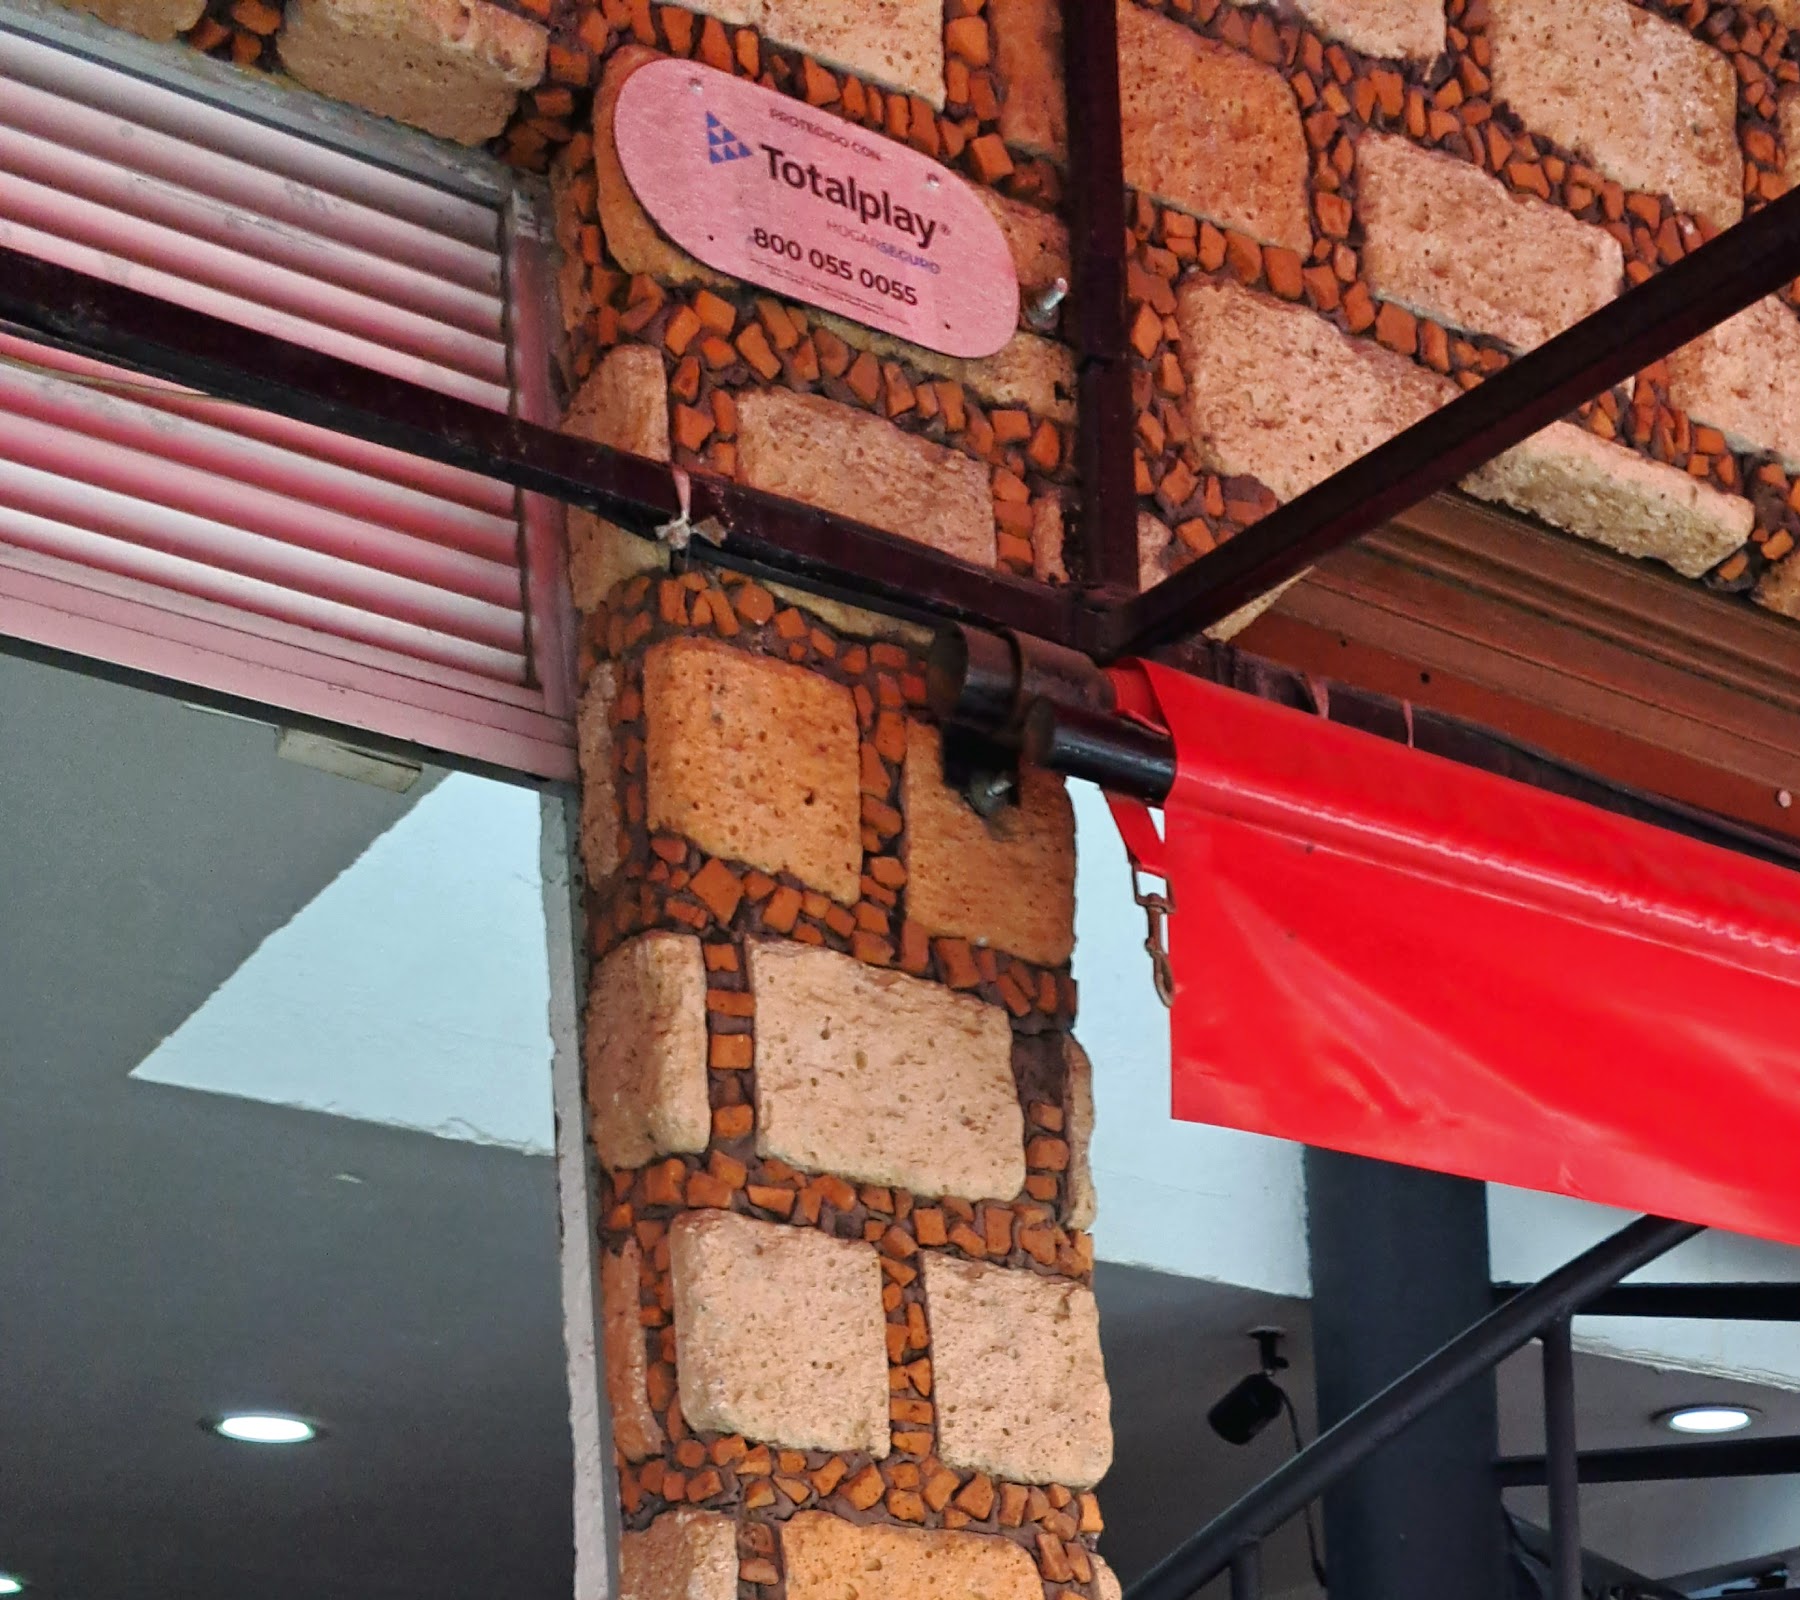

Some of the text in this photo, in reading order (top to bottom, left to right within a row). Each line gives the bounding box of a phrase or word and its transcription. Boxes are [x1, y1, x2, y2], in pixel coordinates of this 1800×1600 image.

[760, 143, 936, 249] Totalplay
[754, 228, 802, 261] 800
[809, 249, 853, 280] 055
[860, 268, 917, 305] 0055
